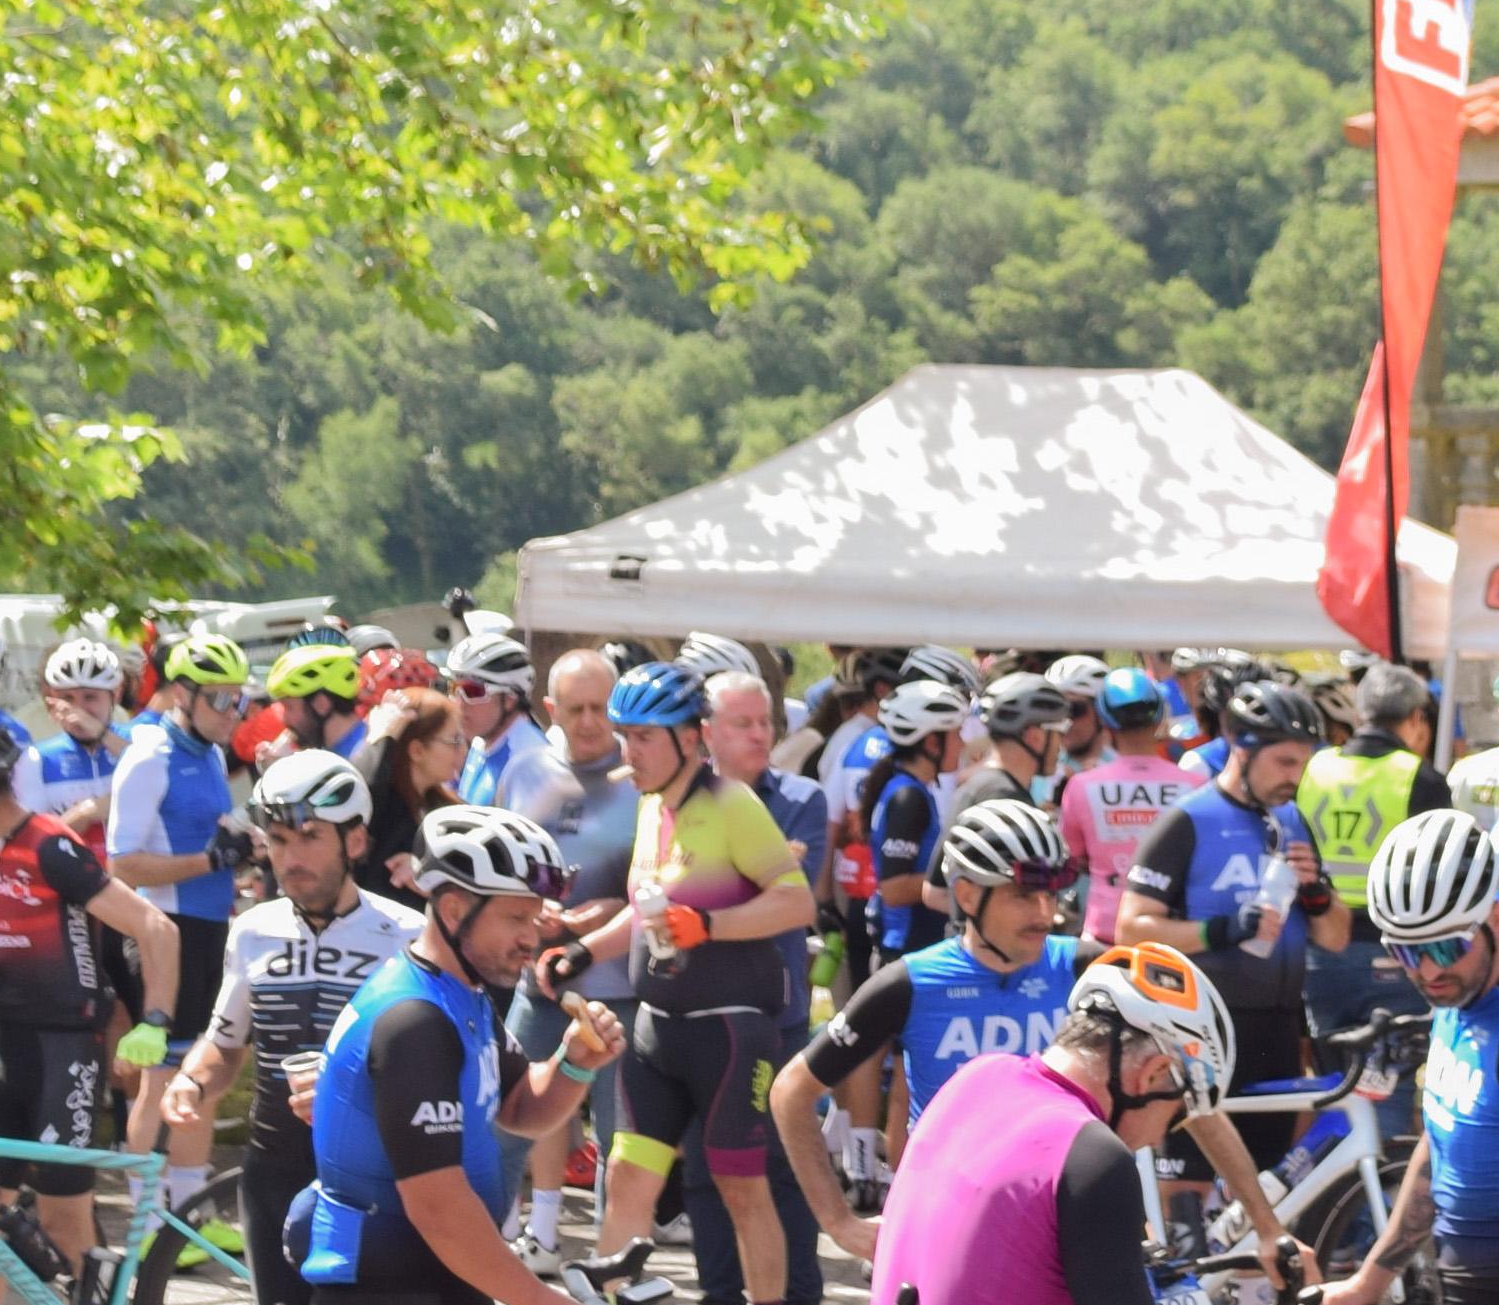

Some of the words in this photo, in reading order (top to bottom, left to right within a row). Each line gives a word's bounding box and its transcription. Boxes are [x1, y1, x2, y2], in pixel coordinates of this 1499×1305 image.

[1100, 782, 1182, 808] UAE
[1331, 809, 1363, 841] 17
[266, 939, 381, 980] diez
